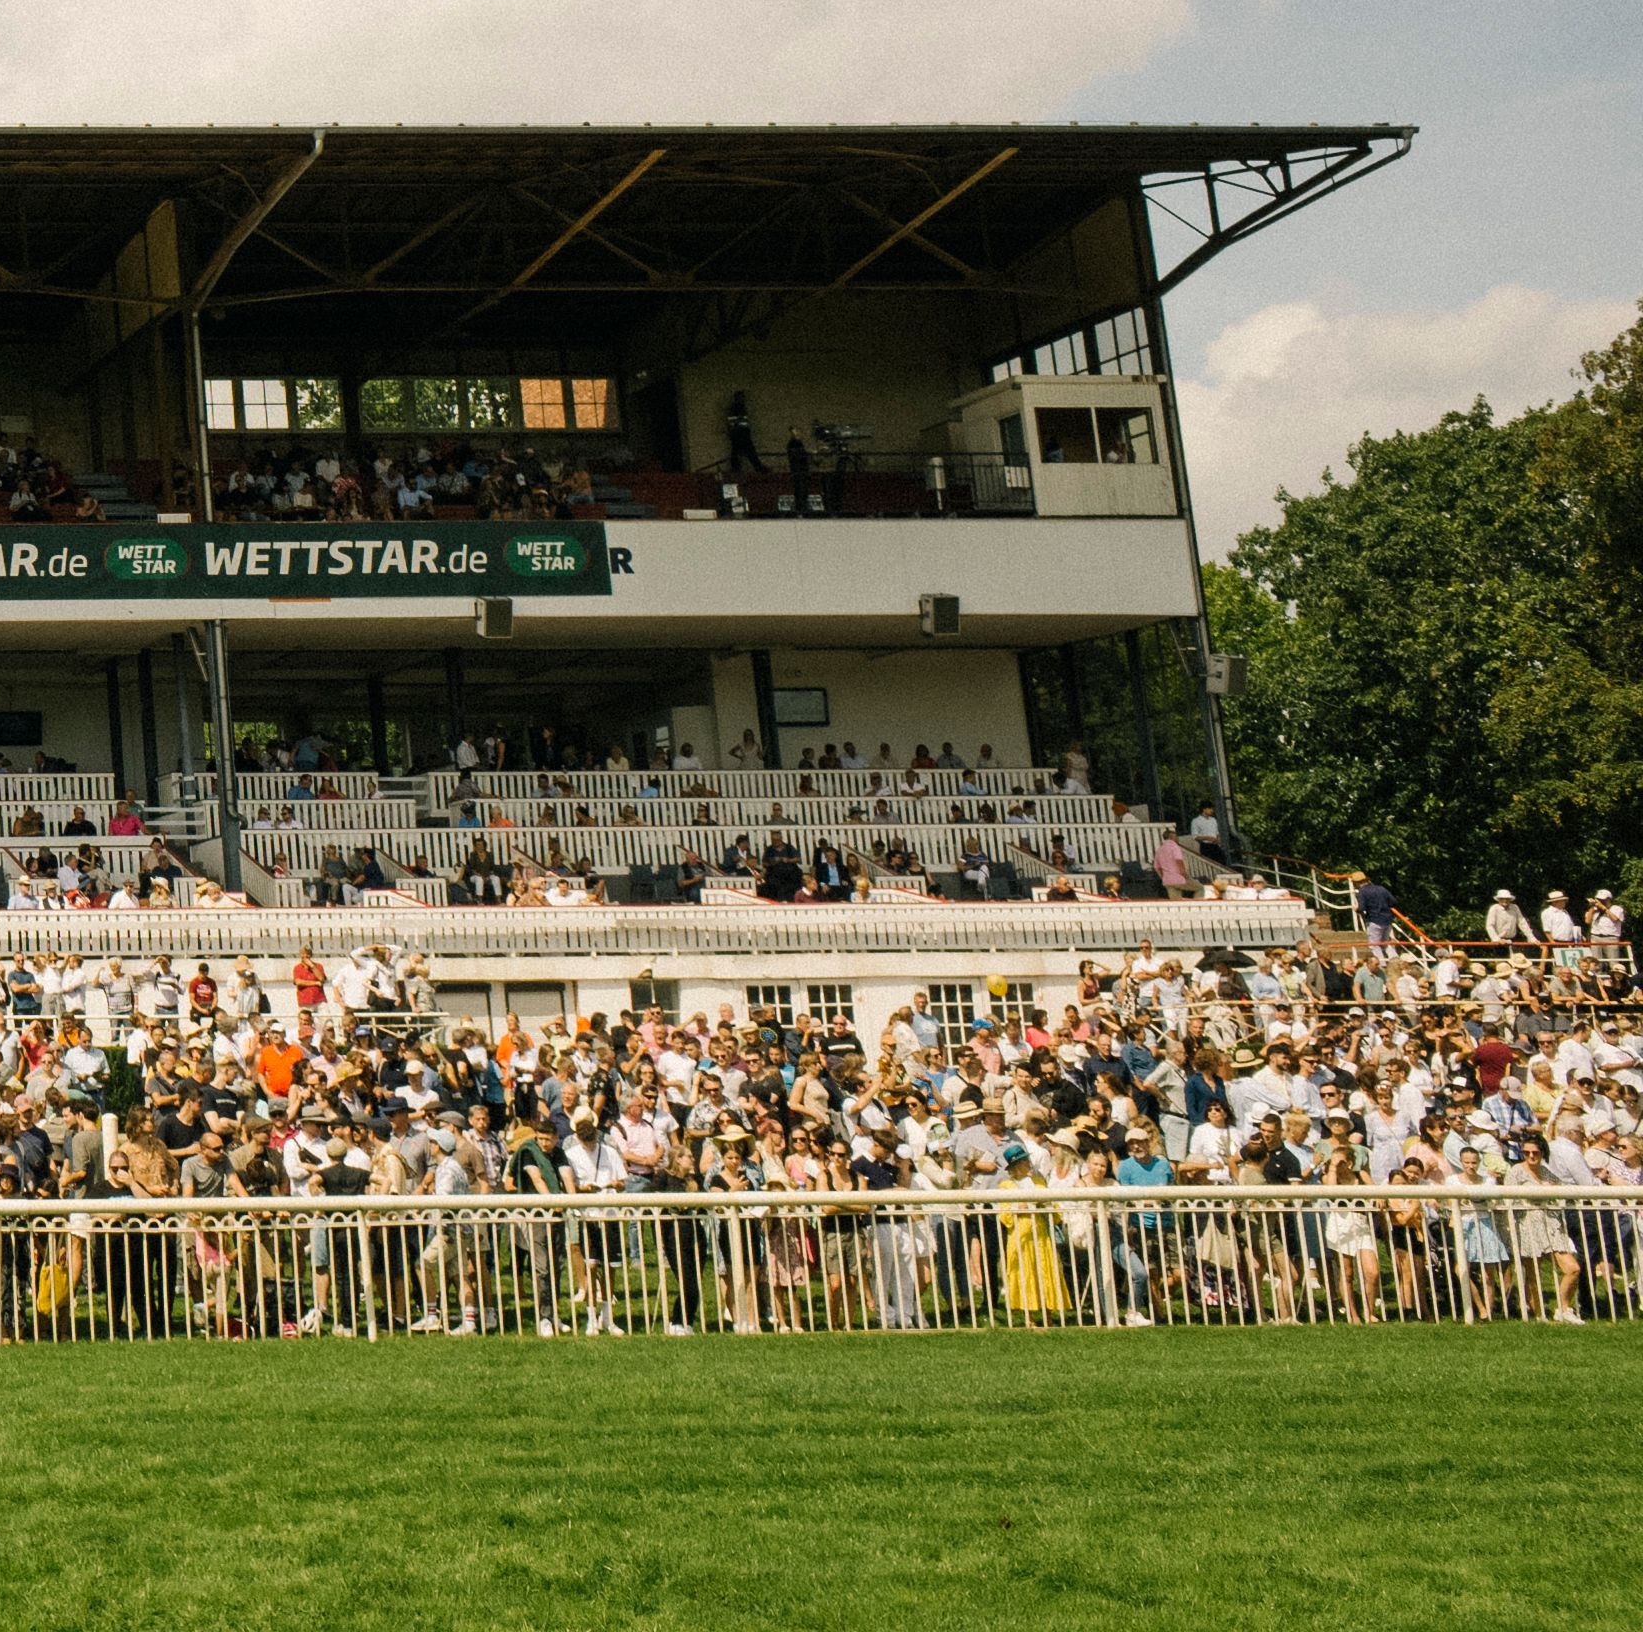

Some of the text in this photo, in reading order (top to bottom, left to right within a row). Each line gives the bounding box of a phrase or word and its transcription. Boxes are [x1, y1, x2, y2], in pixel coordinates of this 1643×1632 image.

[117, 544, 167, 560] WETT
[516, 541, 565, 557] WETT
[204, 539, 488, 576] WETTSTAR.de
[531, 556, 575, 571] STAR
[131, 559, 177, 574] STAR
